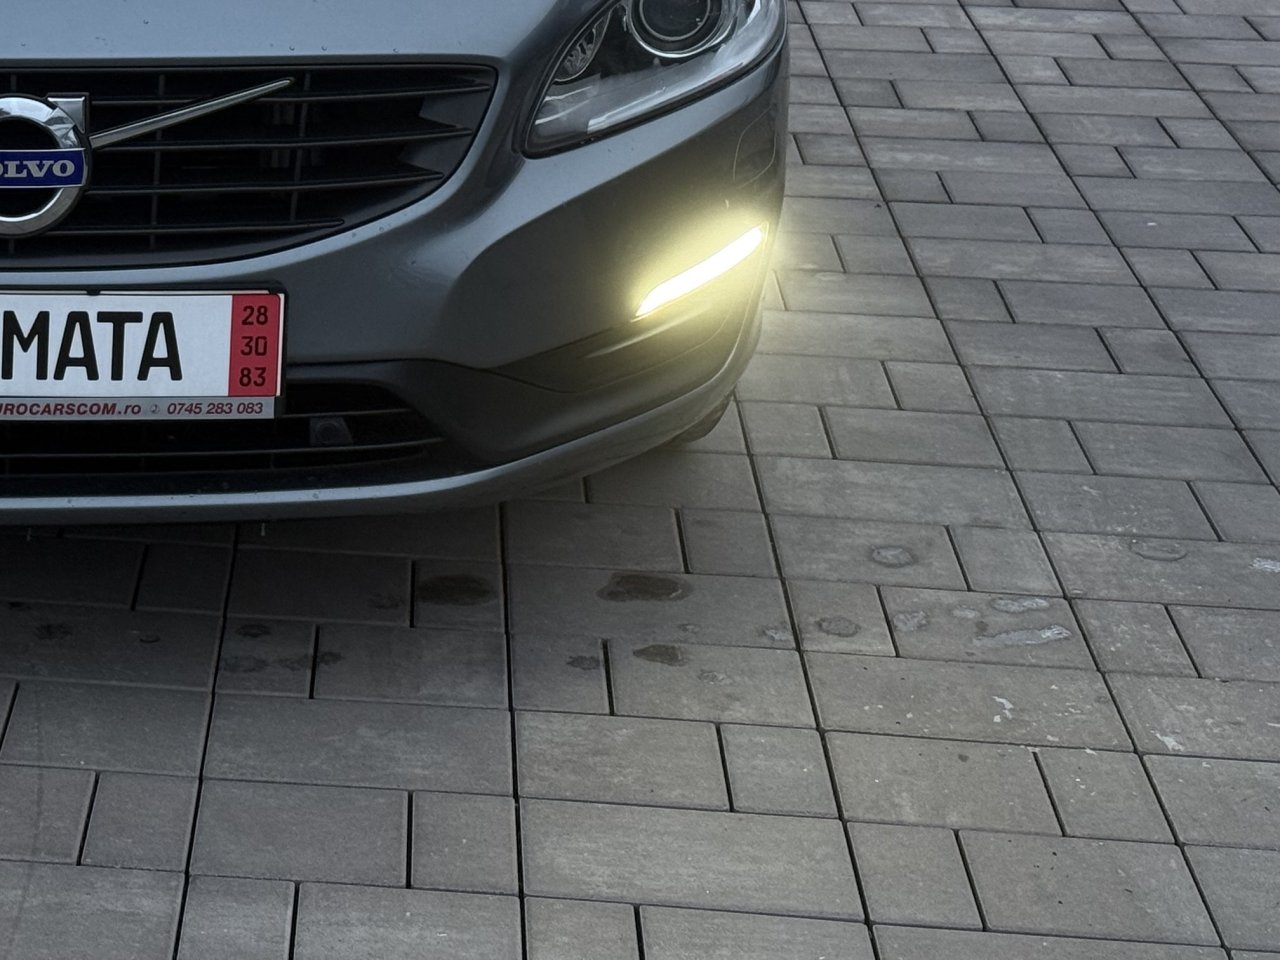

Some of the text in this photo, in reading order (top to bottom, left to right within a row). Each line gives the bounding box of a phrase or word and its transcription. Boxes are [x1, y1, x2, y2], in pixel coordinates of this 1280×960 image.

[241, 305, 268, 326] 28
[240, 336, 267, 356] 30
[239, 367, 267, 387] 83
[167, 402, 202, 415] 0745
[206, 402, 233, 415] 283
[237, 401, 263, 415] 083
